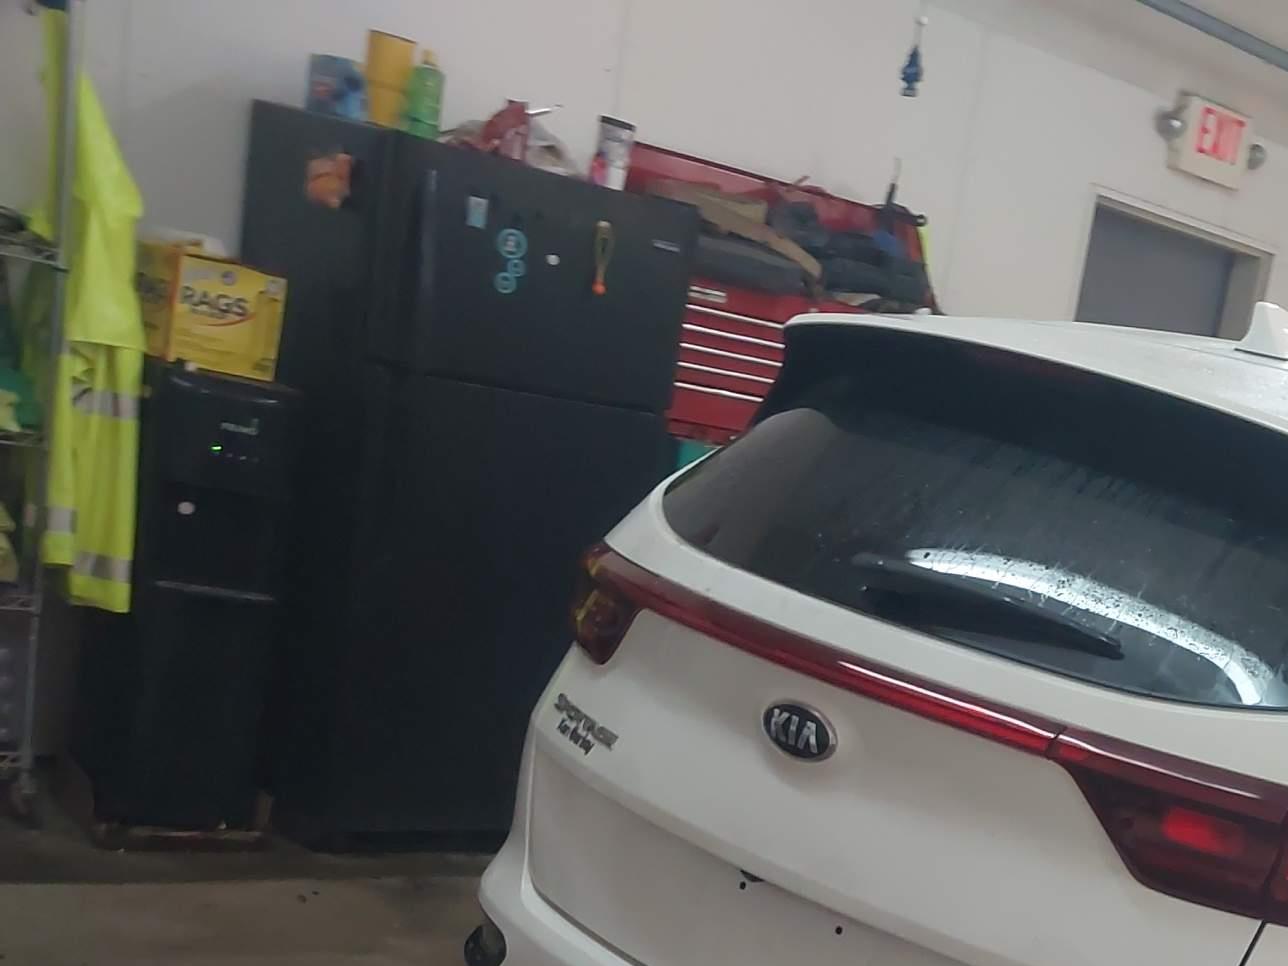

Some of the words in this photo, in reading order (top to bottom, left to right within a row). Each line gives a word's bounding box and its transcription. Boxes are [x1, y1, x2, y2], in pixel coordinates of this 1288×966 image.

[1195, 105, 1246, 165] EXIT
[180, 285, 250, 317] RAGS
[768, 706, 820, 755] KIA
